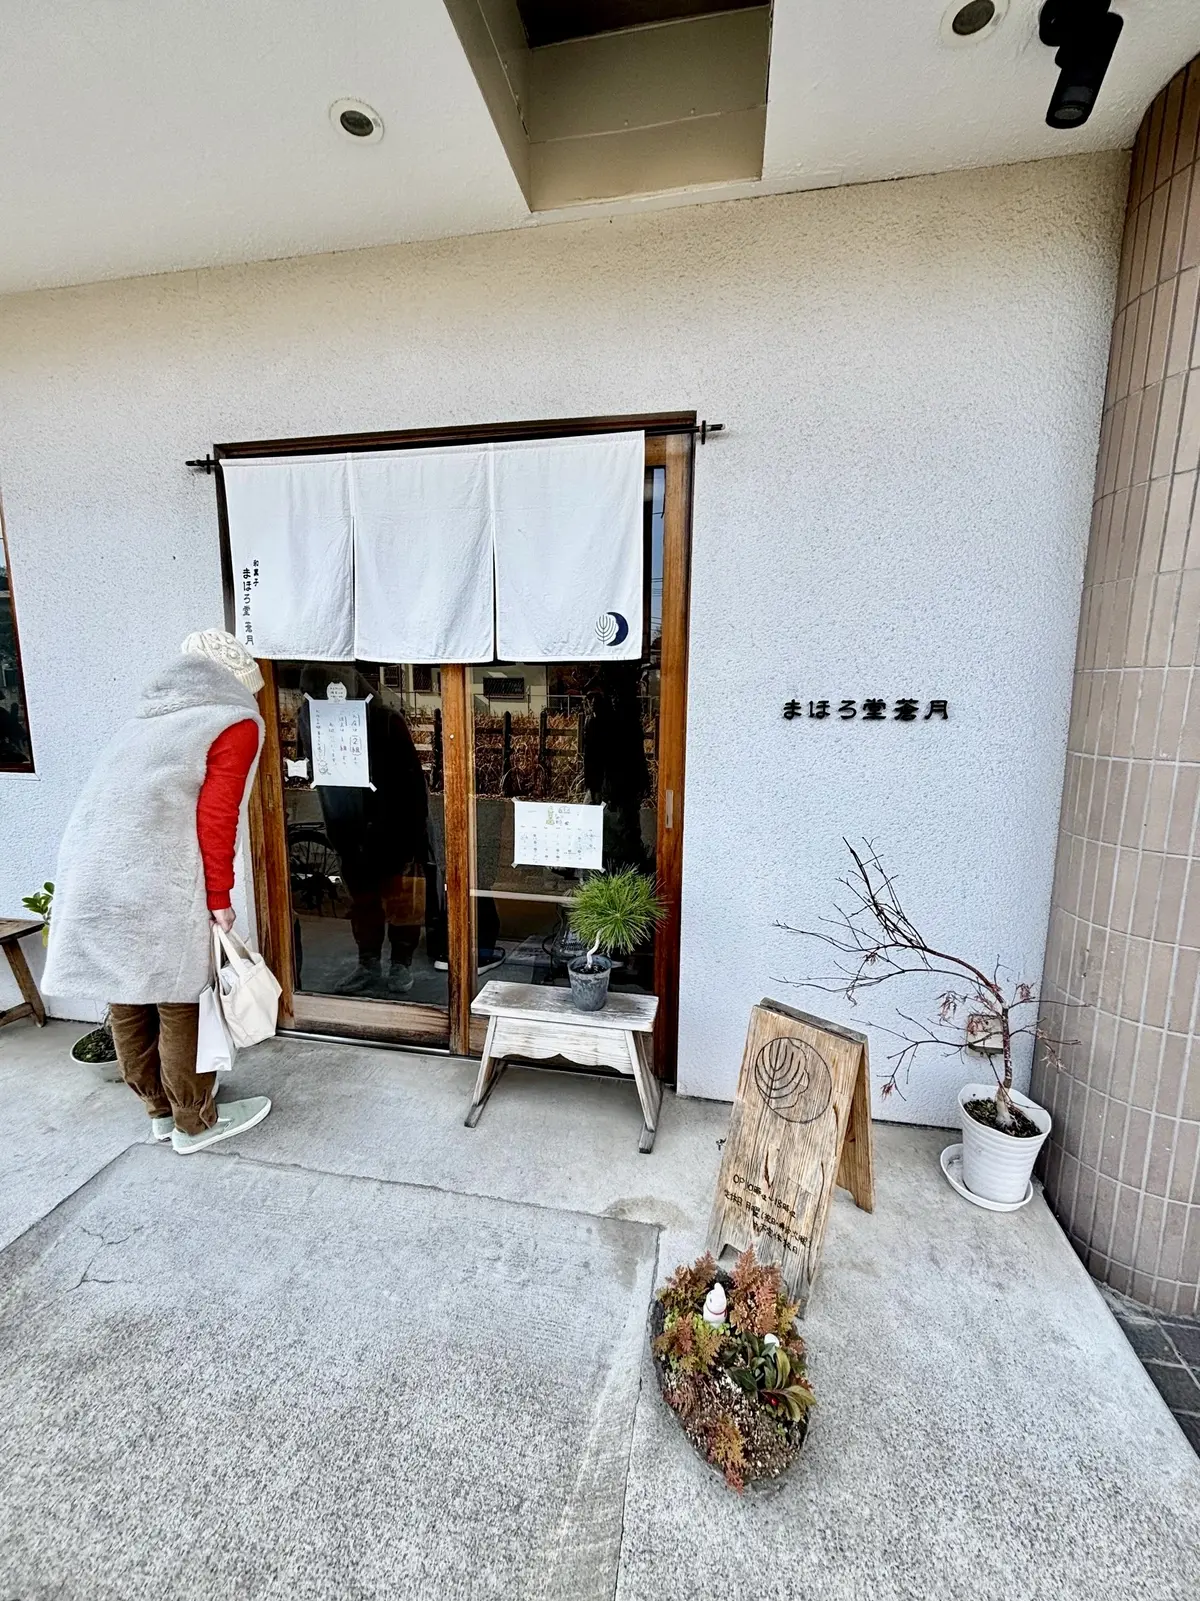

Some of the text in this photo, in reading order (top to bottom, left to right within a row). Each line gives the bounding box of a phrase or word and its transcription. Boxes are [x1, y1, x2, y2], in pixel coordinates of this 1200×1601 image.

[783, 698, 949, 721] まほろ堂蒼月
